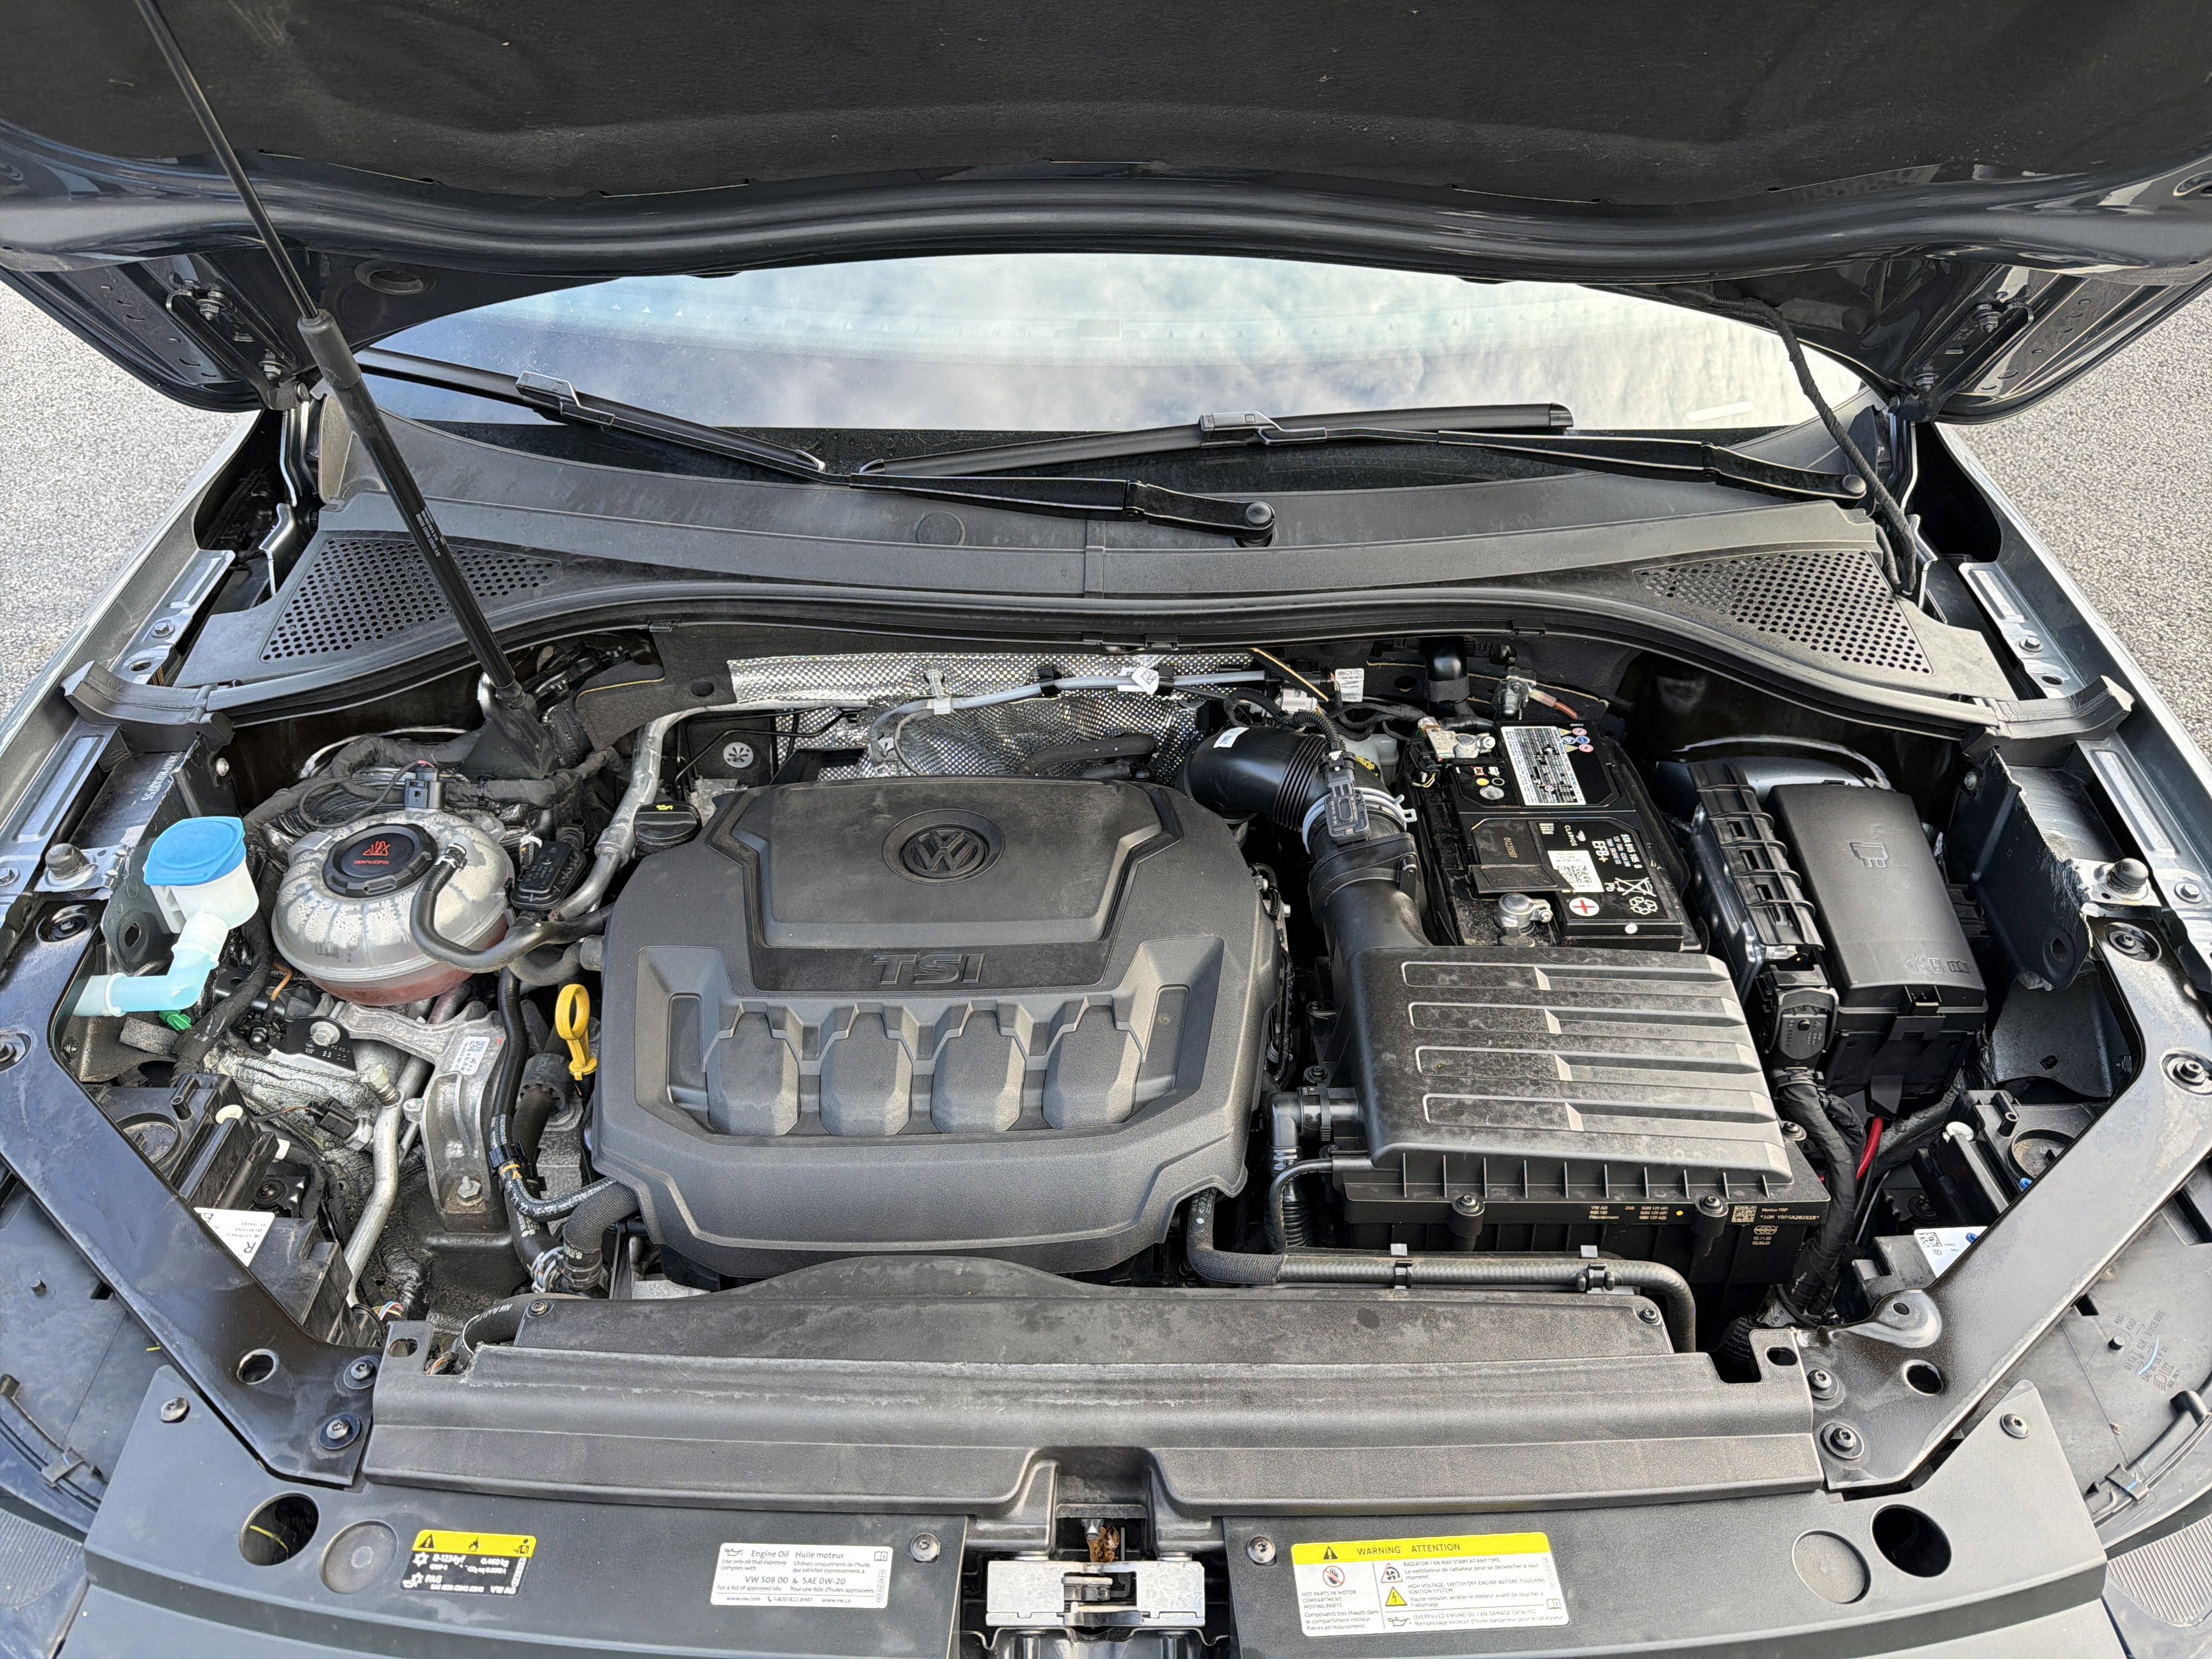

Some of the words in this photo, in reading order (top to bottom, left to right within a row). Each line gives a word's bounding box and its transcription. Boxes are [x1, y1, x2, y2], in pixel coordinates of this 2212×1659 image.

[1564, 825, 1578, 847] CLARIOS
[1592, 841, 1609, 863] EFB+
[1625, 843, 1635, 853] 915
[1604, 883, 1615, 892] Pb
[872, 953, 985, 985] TSI
[244, 1242, 257, 1254] R
[1357, 1545, 1401, 1555] WARNING
[1412, 1543, 1460, 1553] ATTENTION
[425, 1575, 442, 1583] PAG
